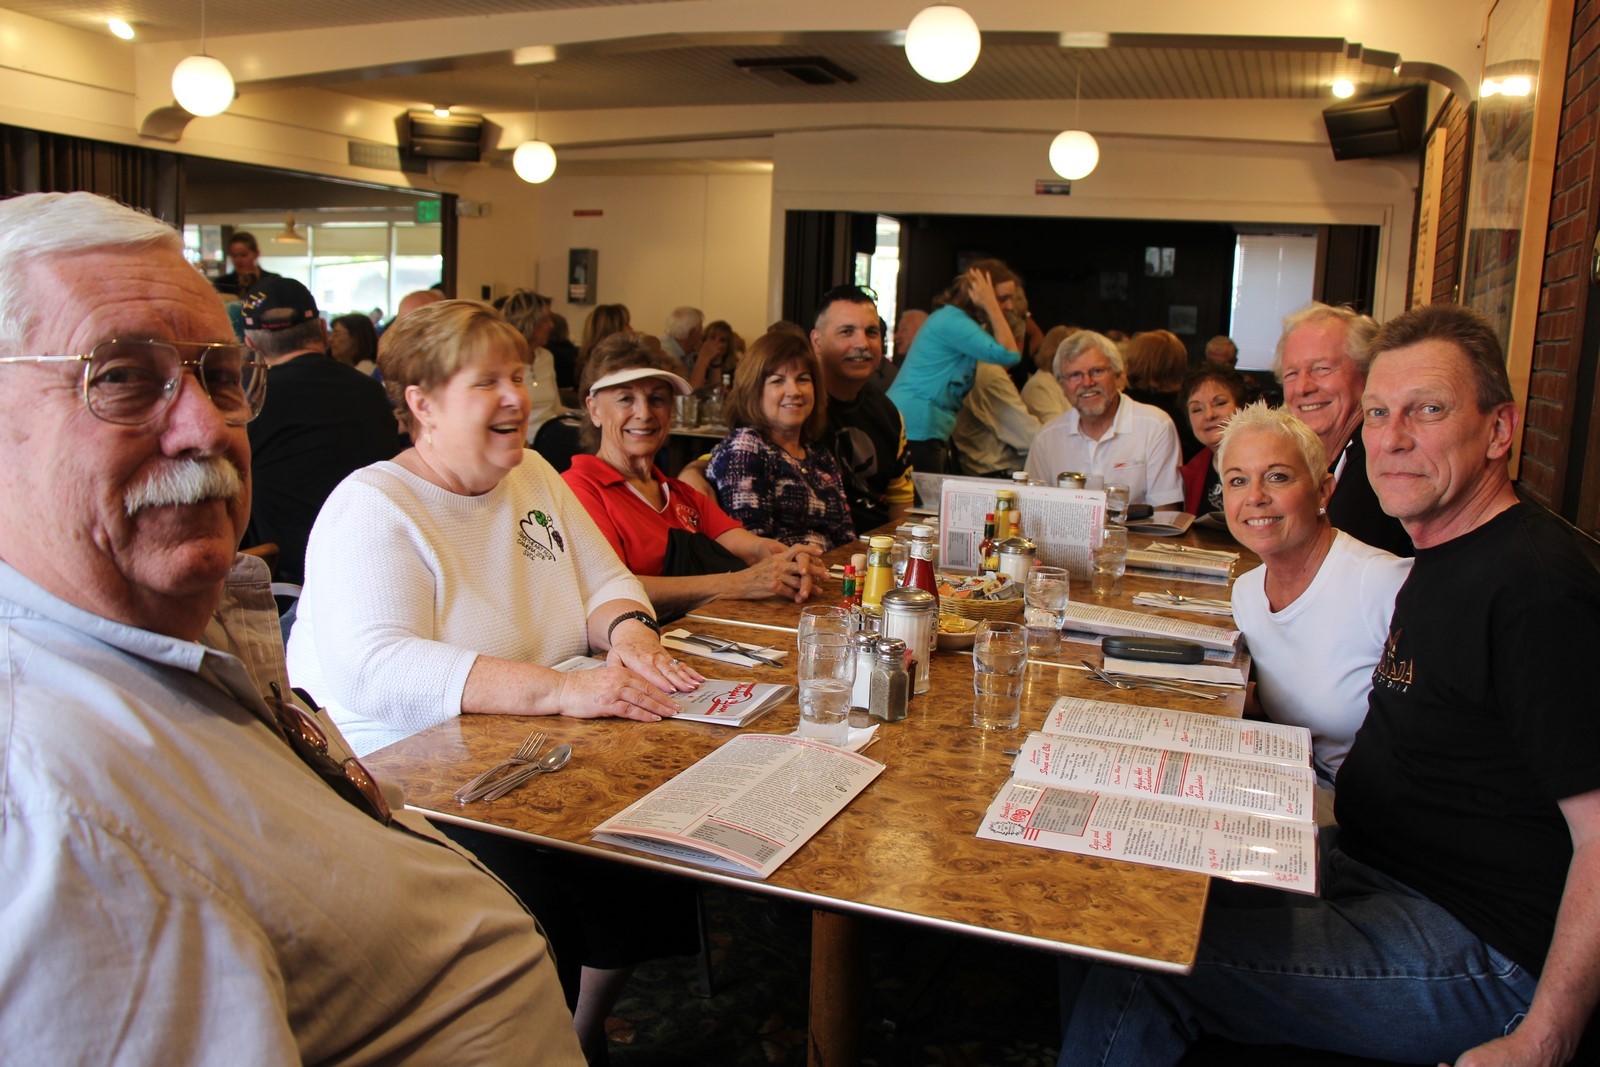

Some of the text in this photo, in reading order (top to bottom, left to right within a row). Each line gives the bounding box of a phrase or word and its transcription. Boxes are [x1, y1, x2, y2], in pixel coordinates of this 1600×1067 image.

[1040, 761, 1051, 775] Soup
[1133, 767, 1143, 789] Huge Hot
[1143, 766, 1152, 793] Sandwiches
[1194, 774, 1204, 800] Sandwiches
[1185, 784, 1194, 797] Tasty
[1089, 840, 1101, 851] Eggs
